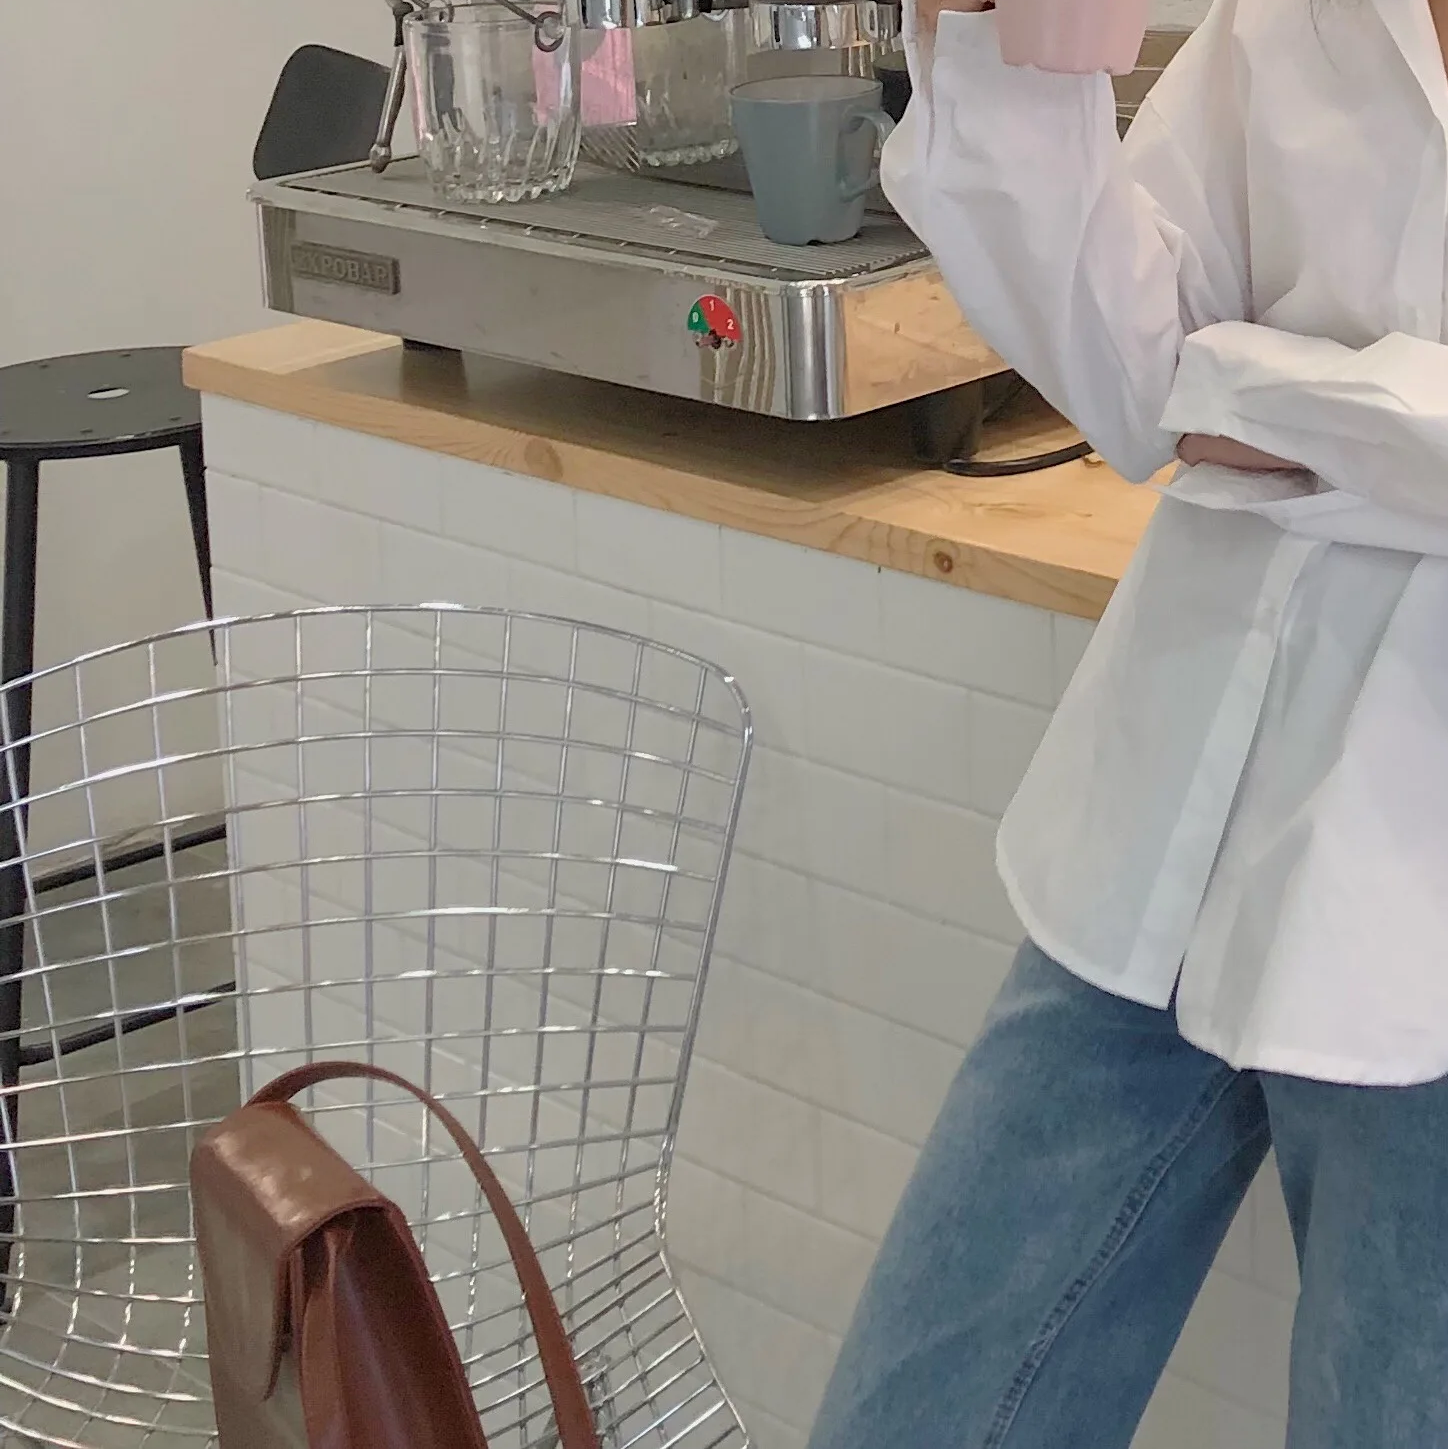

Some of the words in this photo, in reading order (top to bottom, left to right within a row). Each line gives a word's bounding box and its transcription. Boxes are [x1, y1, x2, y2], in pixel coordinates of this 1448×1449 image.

[709, 299, 715, 312] 1
[692, 311, 699, 323] 0
[726, 318, 735, 330] 2
